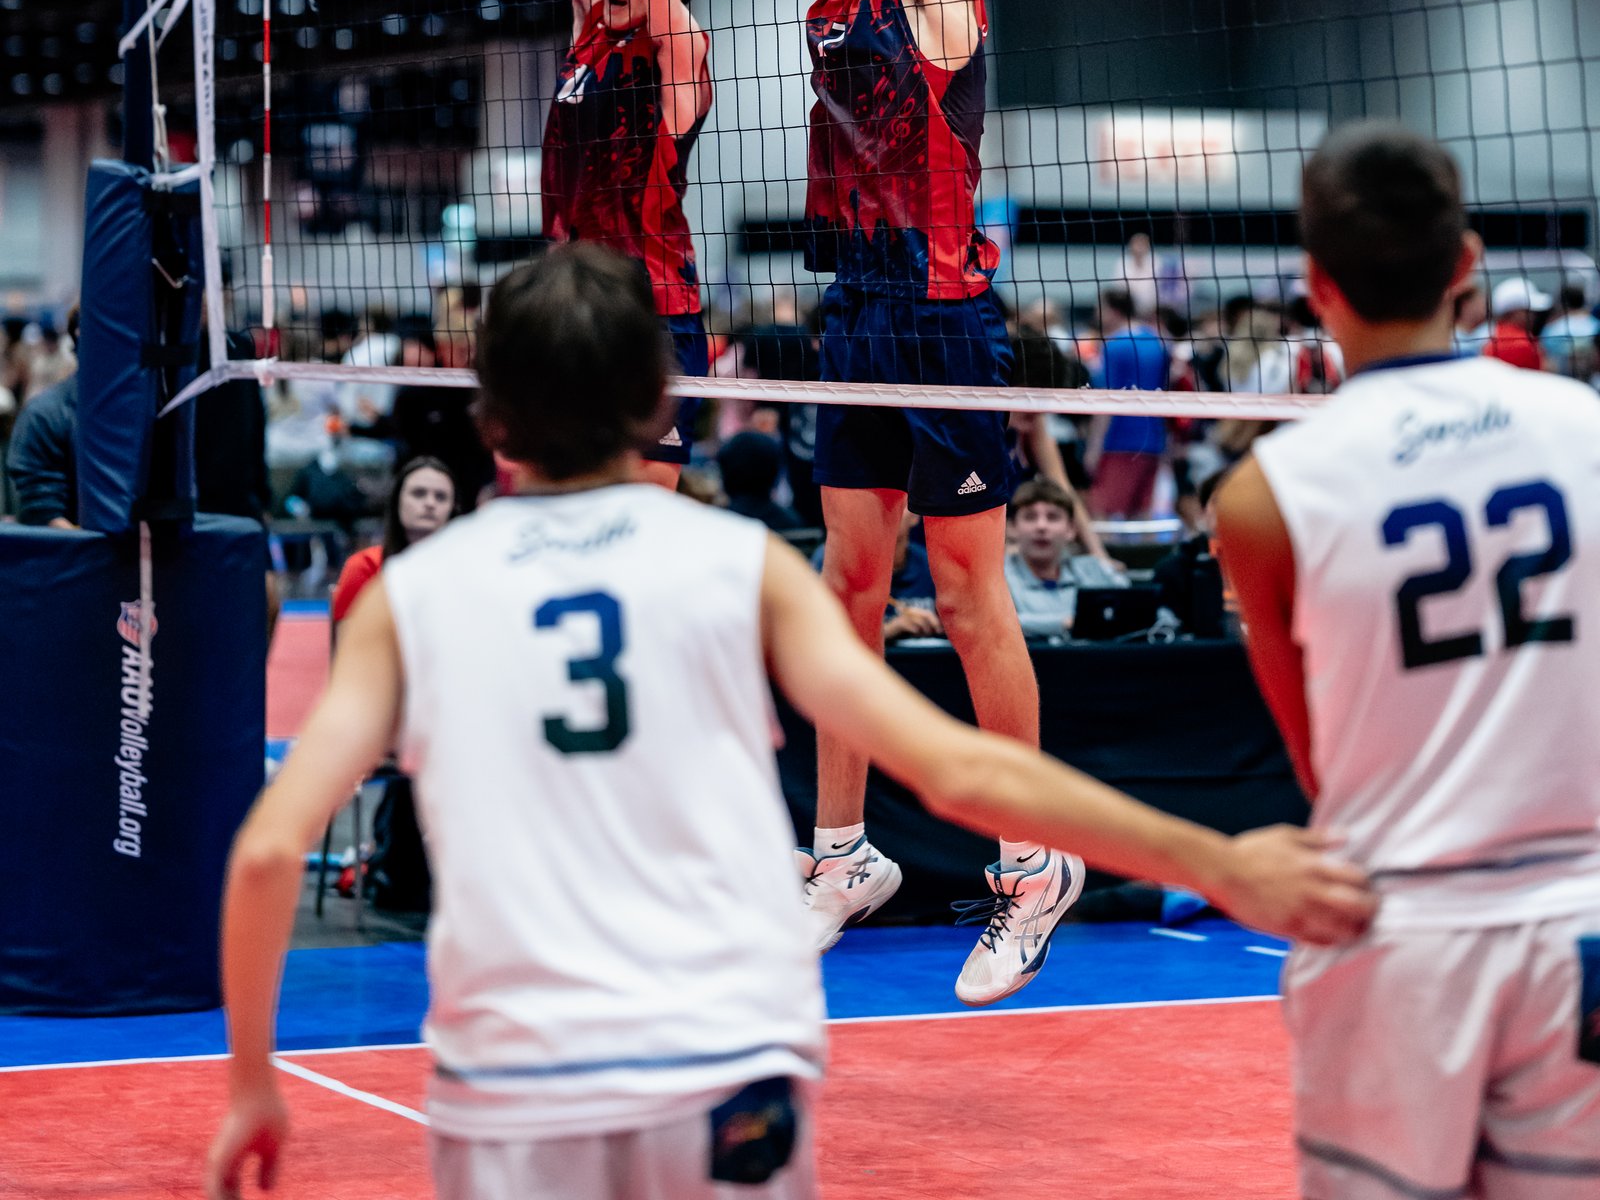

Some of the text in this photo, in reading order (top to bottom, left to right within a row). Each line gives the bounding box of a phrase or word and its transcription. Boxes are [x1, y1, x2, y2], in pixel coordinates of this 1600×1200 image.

[957, 483, 987, 495] adidas
[1382, 480, 1573, 669] 22
[534, 590, 630, 754] 3
